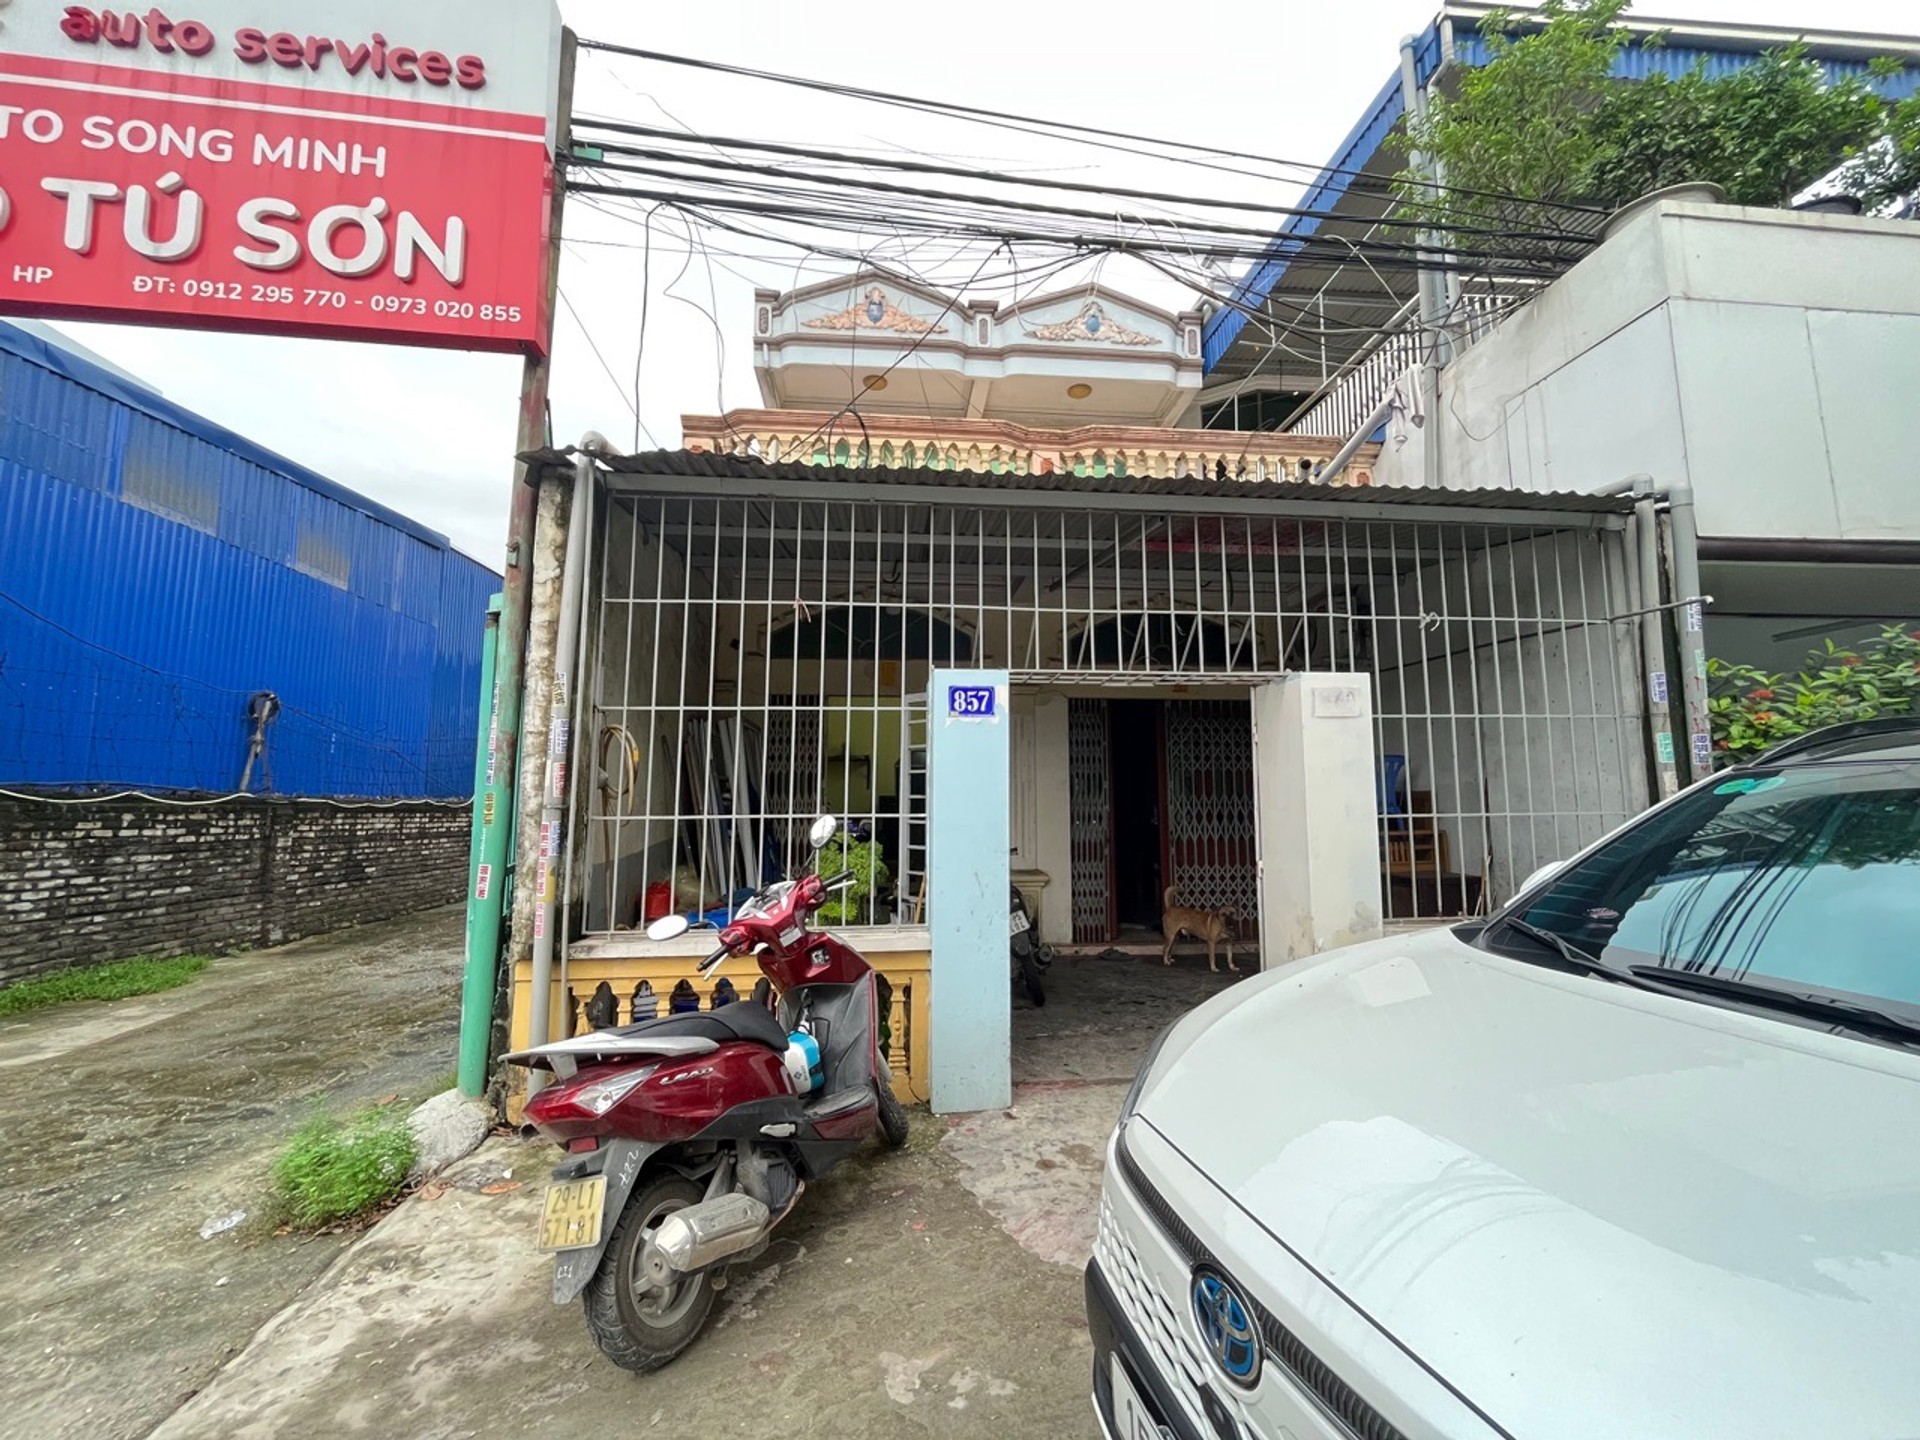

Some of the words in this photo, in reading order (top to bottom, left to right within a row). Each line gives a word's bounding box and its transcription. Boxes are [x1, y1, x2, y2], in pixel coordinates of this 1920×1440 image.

[60, 6, 216, 57] auto
[234, 31, 487, 90] services
[80, 115, 234, 163] SONG
[252, 133, 387, 179] MINH
[40, 170, 204, 262] TÚ
[232, 196, 466, 285] SƠN
[13, 264, 54, 284] HP
[132, 275, 176, 294] ĐT:
[183, 279, 243, 300] 0912
[250, 284, 294, 304] 295
[303, 288, 347, 309] 770
[370, 295, 427, 315] 0973
[434, 300, 474, 319] 020
[479, 304, 522, 323] 855
[953, 689, 990, 713] 857
